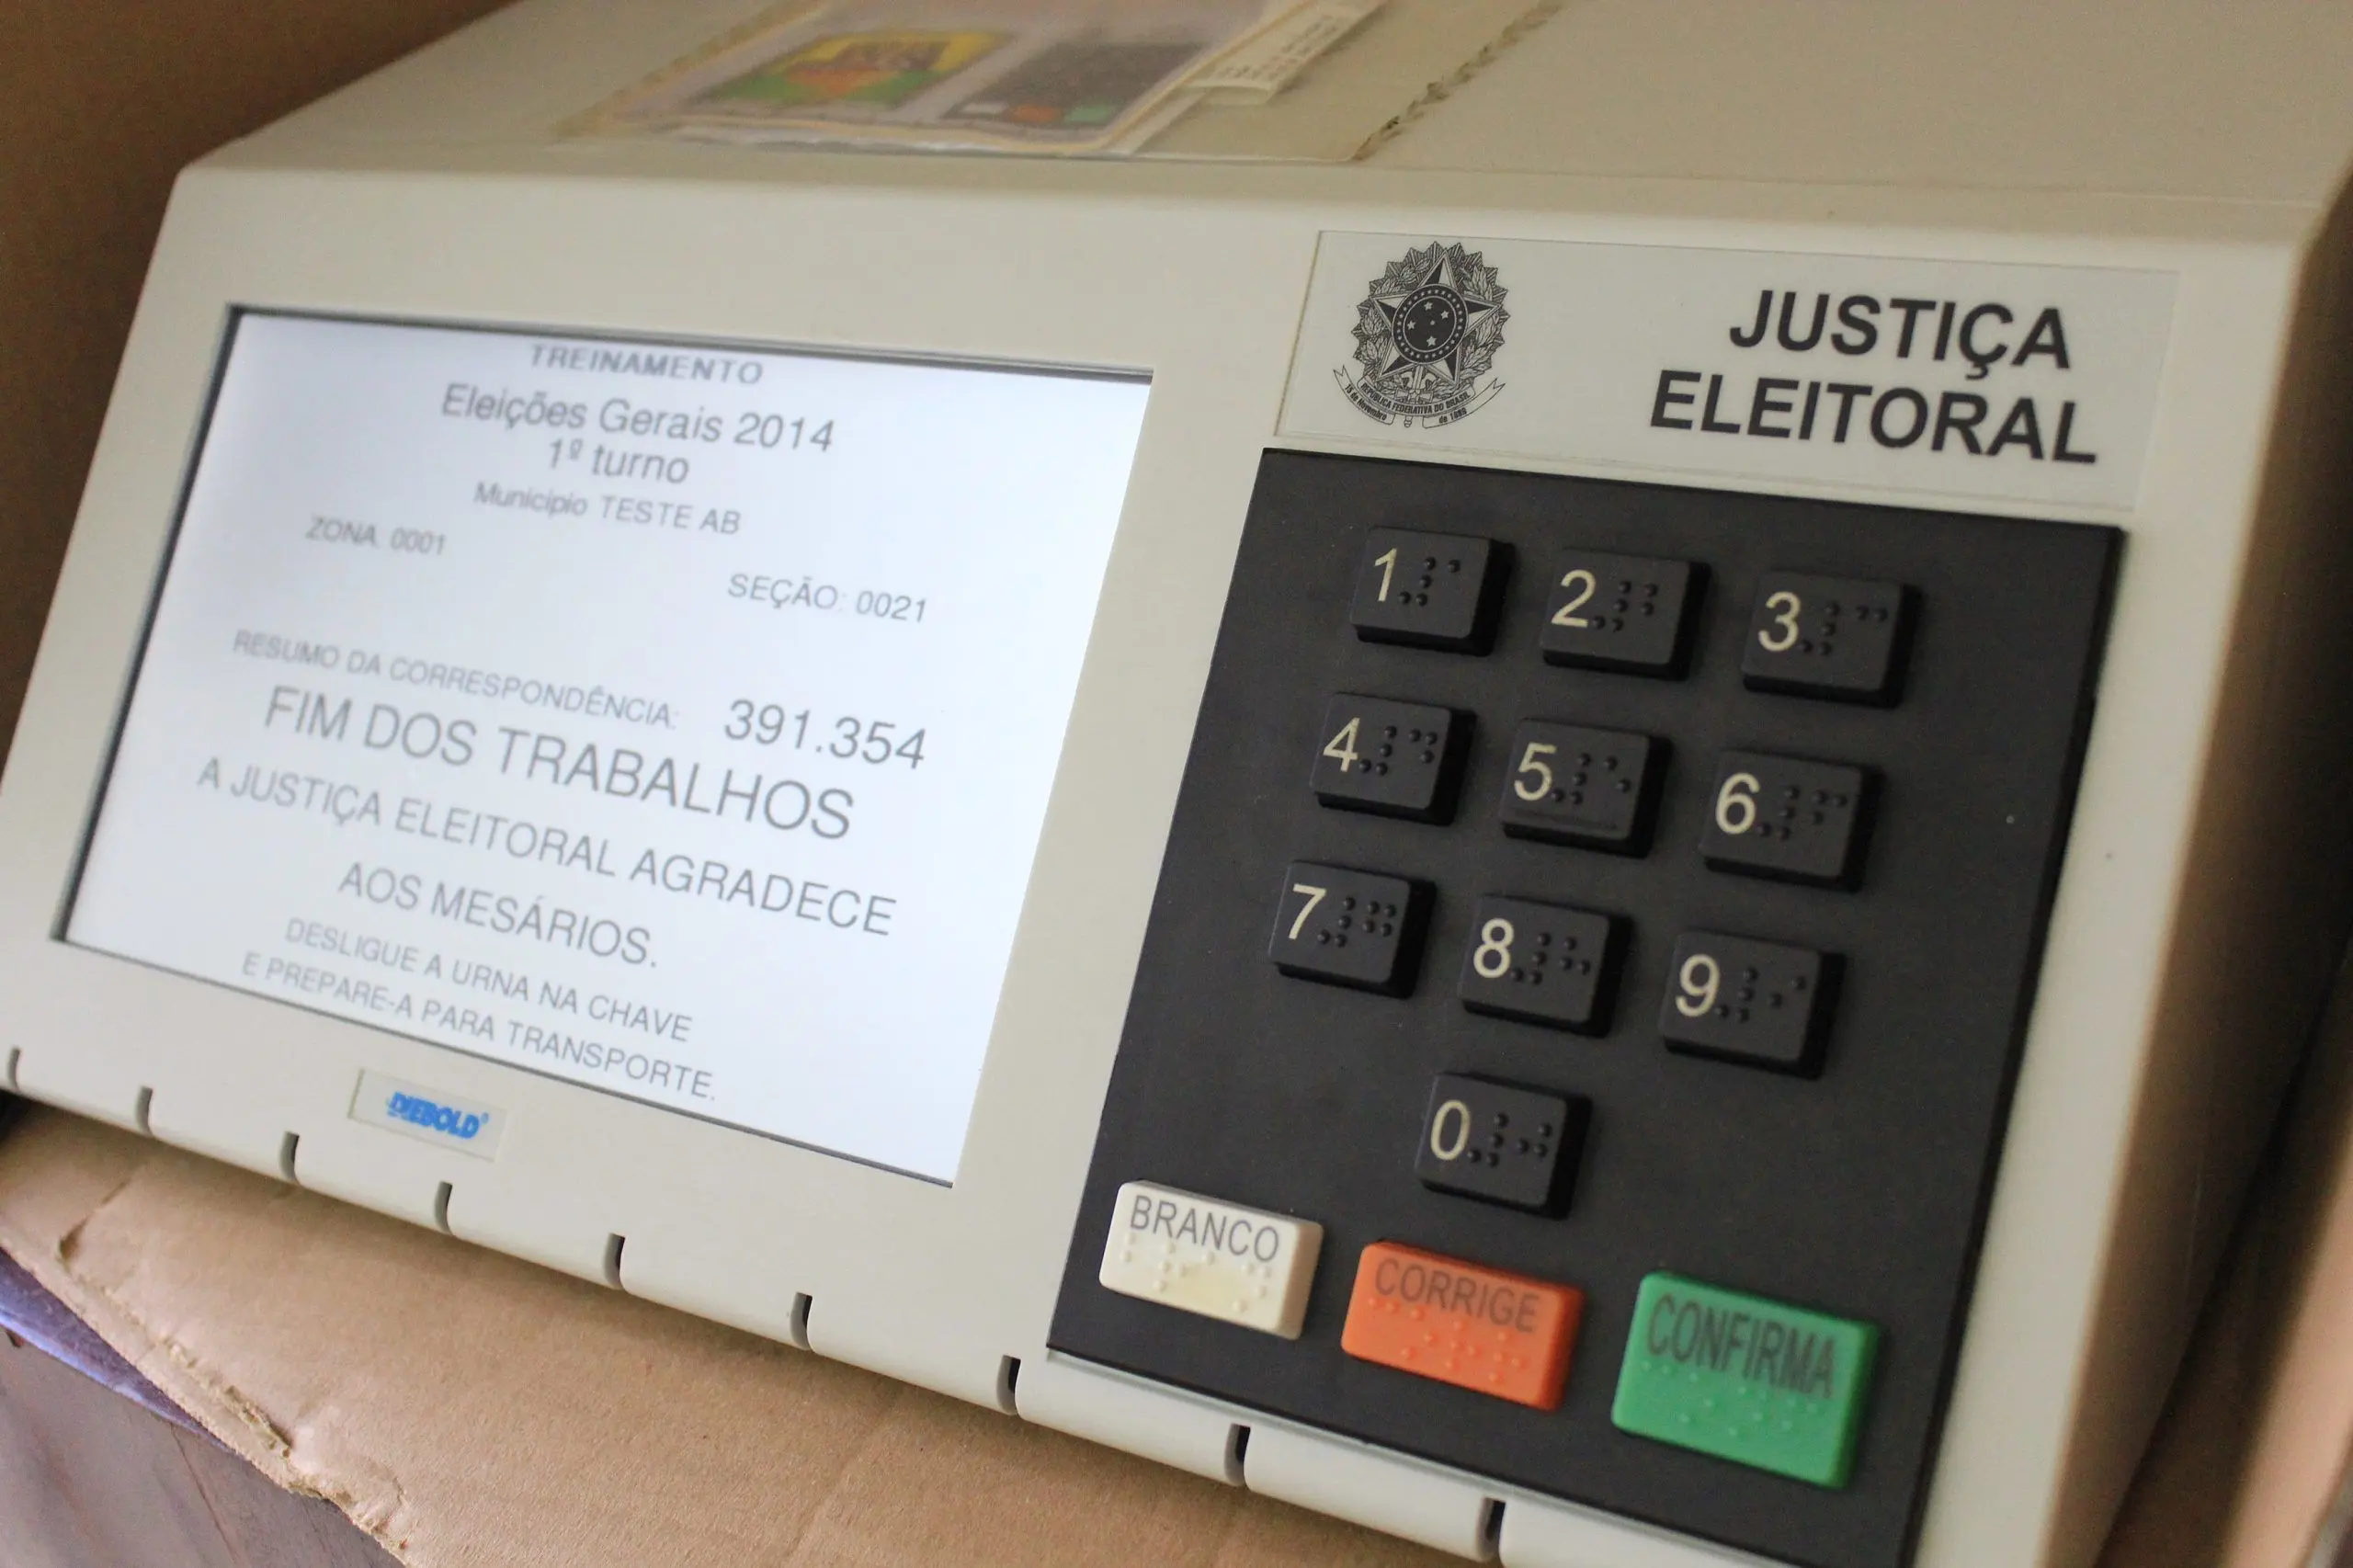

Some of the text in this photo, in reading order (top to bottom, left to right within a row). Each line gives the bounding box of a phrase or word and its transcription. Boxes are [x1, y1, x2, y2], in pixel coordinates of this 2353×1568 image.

[529, 344, 764, 385] TREINAMENTO
[1729, 289, 2072, 381] JUSTIÇA
[441, 381, 835, 453] Eleições Gerais 2014
[1446, 392, 1471, 409] BRASIL
[1650, 369, 2097, 464] ELEITORAL
[591, 442, 691, 484] turno
[390, 525, 449, 554] 0001
[600, 494, 691, 530] TESTE
[699, 507, 742, 535] AB
[855, 589, 928, 624] 0021
[1374, 548, 1397, 603] 1
[1551, 568, 1597, 629] 2
[1757, 590, 1802, 653] 3
[233, 628, 927, 770] RESUMO DA CORRESPONDÊNCIA: 391.354
[264, 684, 855, 840] FIM DOS TRABALHOS
[1323, 716, 1361, 773] 4
[1513, 742, 1558, 801] 5
[1714, 772, 1760, 835] 6
[197, 756, 897, 937] A JUSTIÇA ELEITORAL AGRADECE
[337, 860, 658, 968] AOS MESÁRIOS.
[1287, 882, 1326, 940] 7
[285, 916, 693, 1043] DESLIGUE A URNA NA CHAVE
[1472, 918, 1515, 979] 8
[1674, 953, 1722, 1017] 9
[241, 950, 717, 1102] E PREPARE-A PARA TRANSPORTE.
[1428, 1098, 1471, 1162] 0
[1131, 1193, 1280, 1264] BRANCO
[1374, 1256, 1539, 1334] CORRIGE
[1646, 1294, 1836, 1402] CONFIRMA
